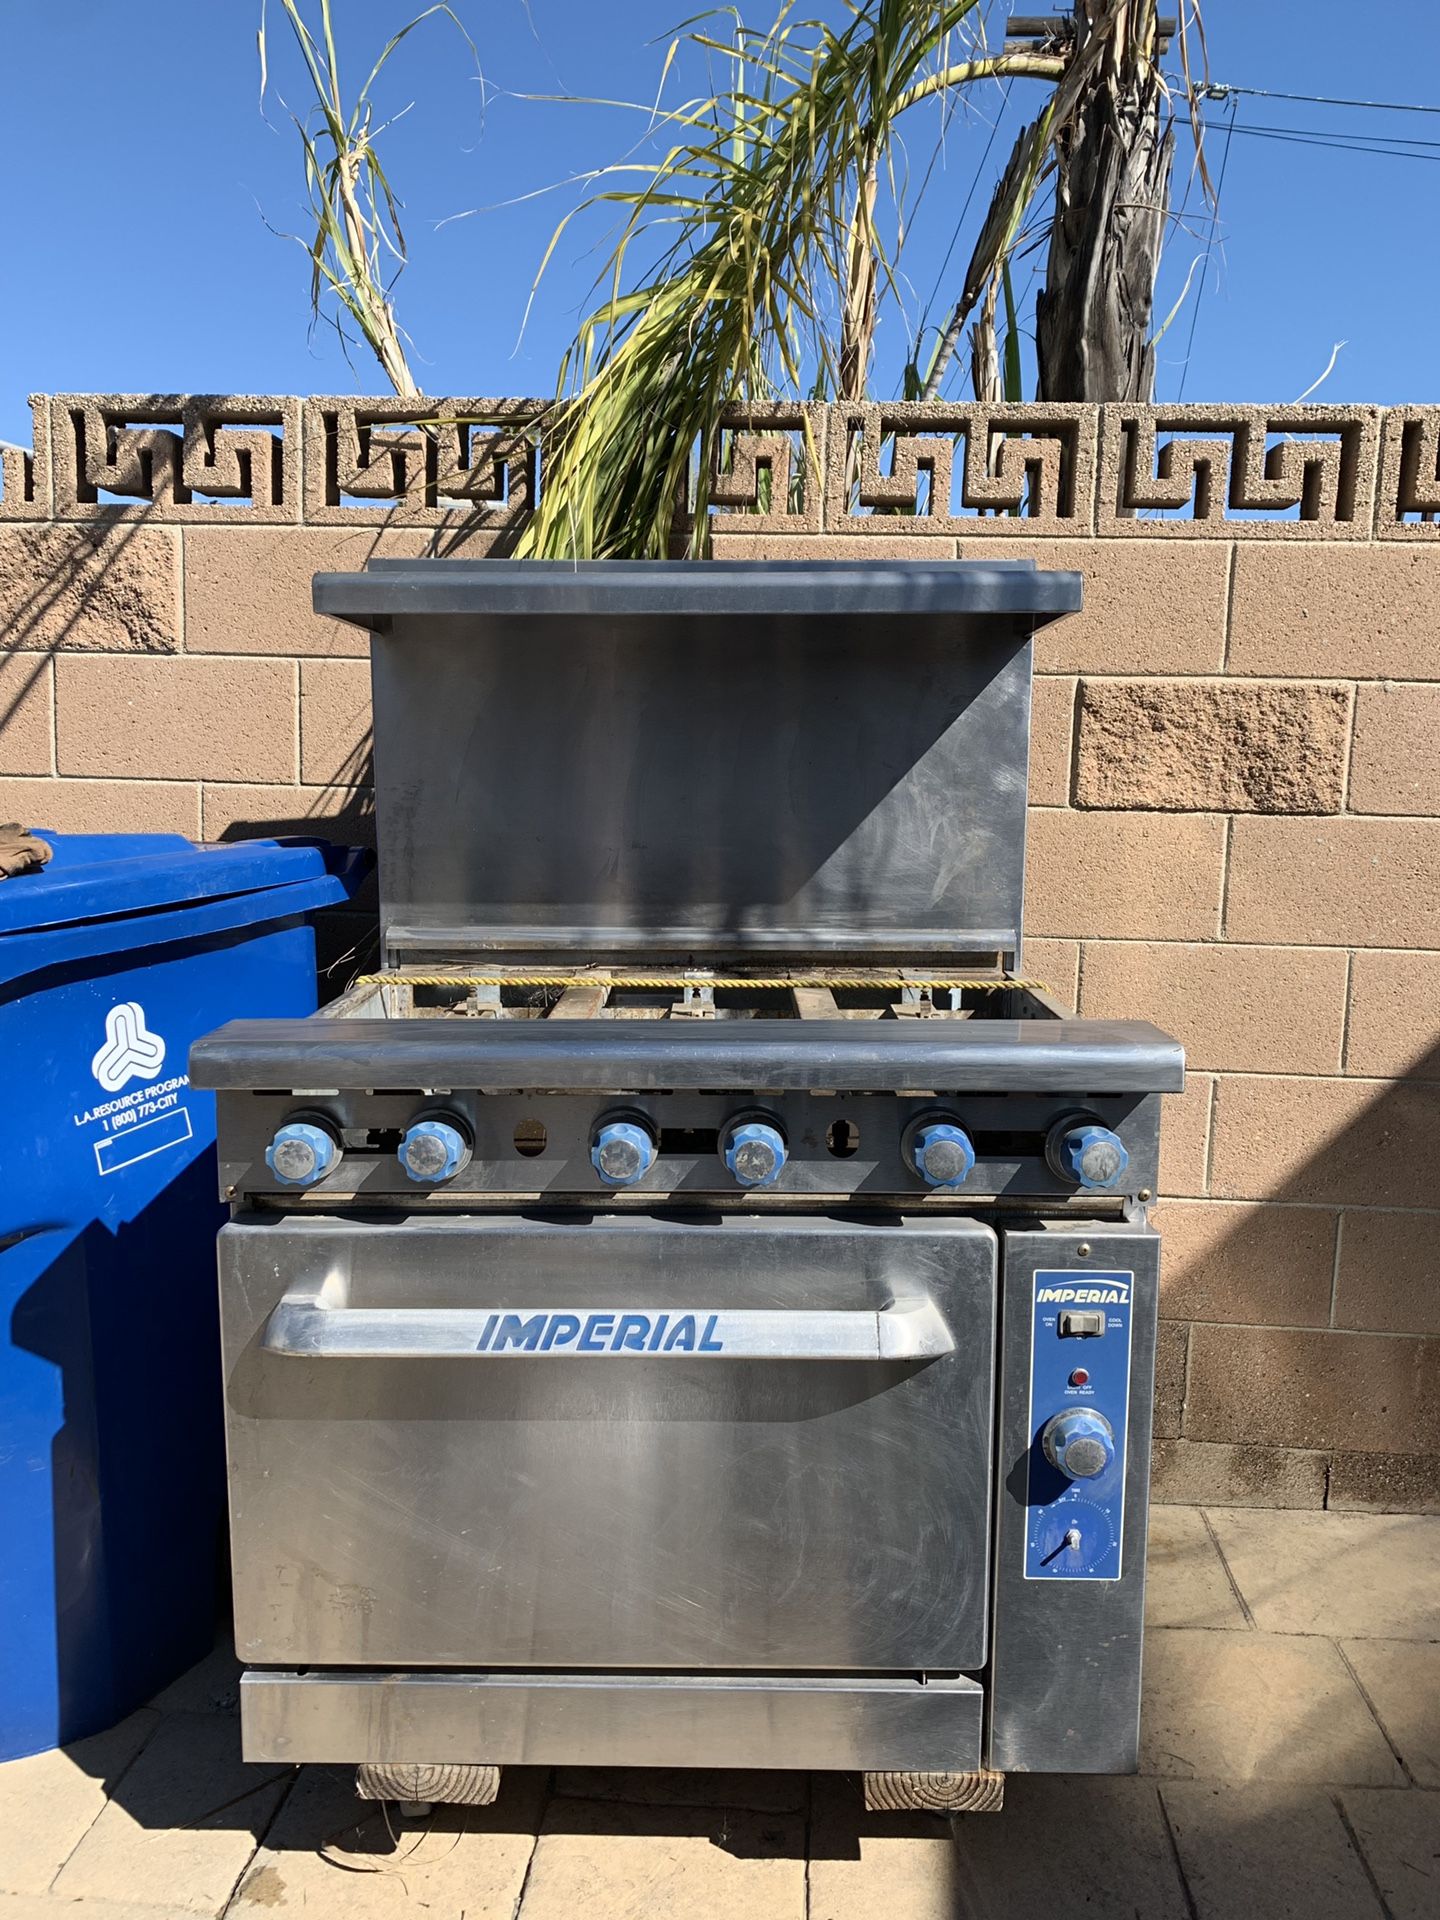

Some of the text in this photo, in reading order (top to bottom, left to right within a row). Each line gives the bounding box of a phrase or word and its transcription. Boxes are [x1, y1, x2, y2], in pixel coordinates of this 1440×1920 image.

[102, 1092, 178, 1131] 1 (800) 773-CITY
[1036, 1288, 1130, 1304] IMPERIAL
[476, 1314, 723, 1351] IMPERIAL
